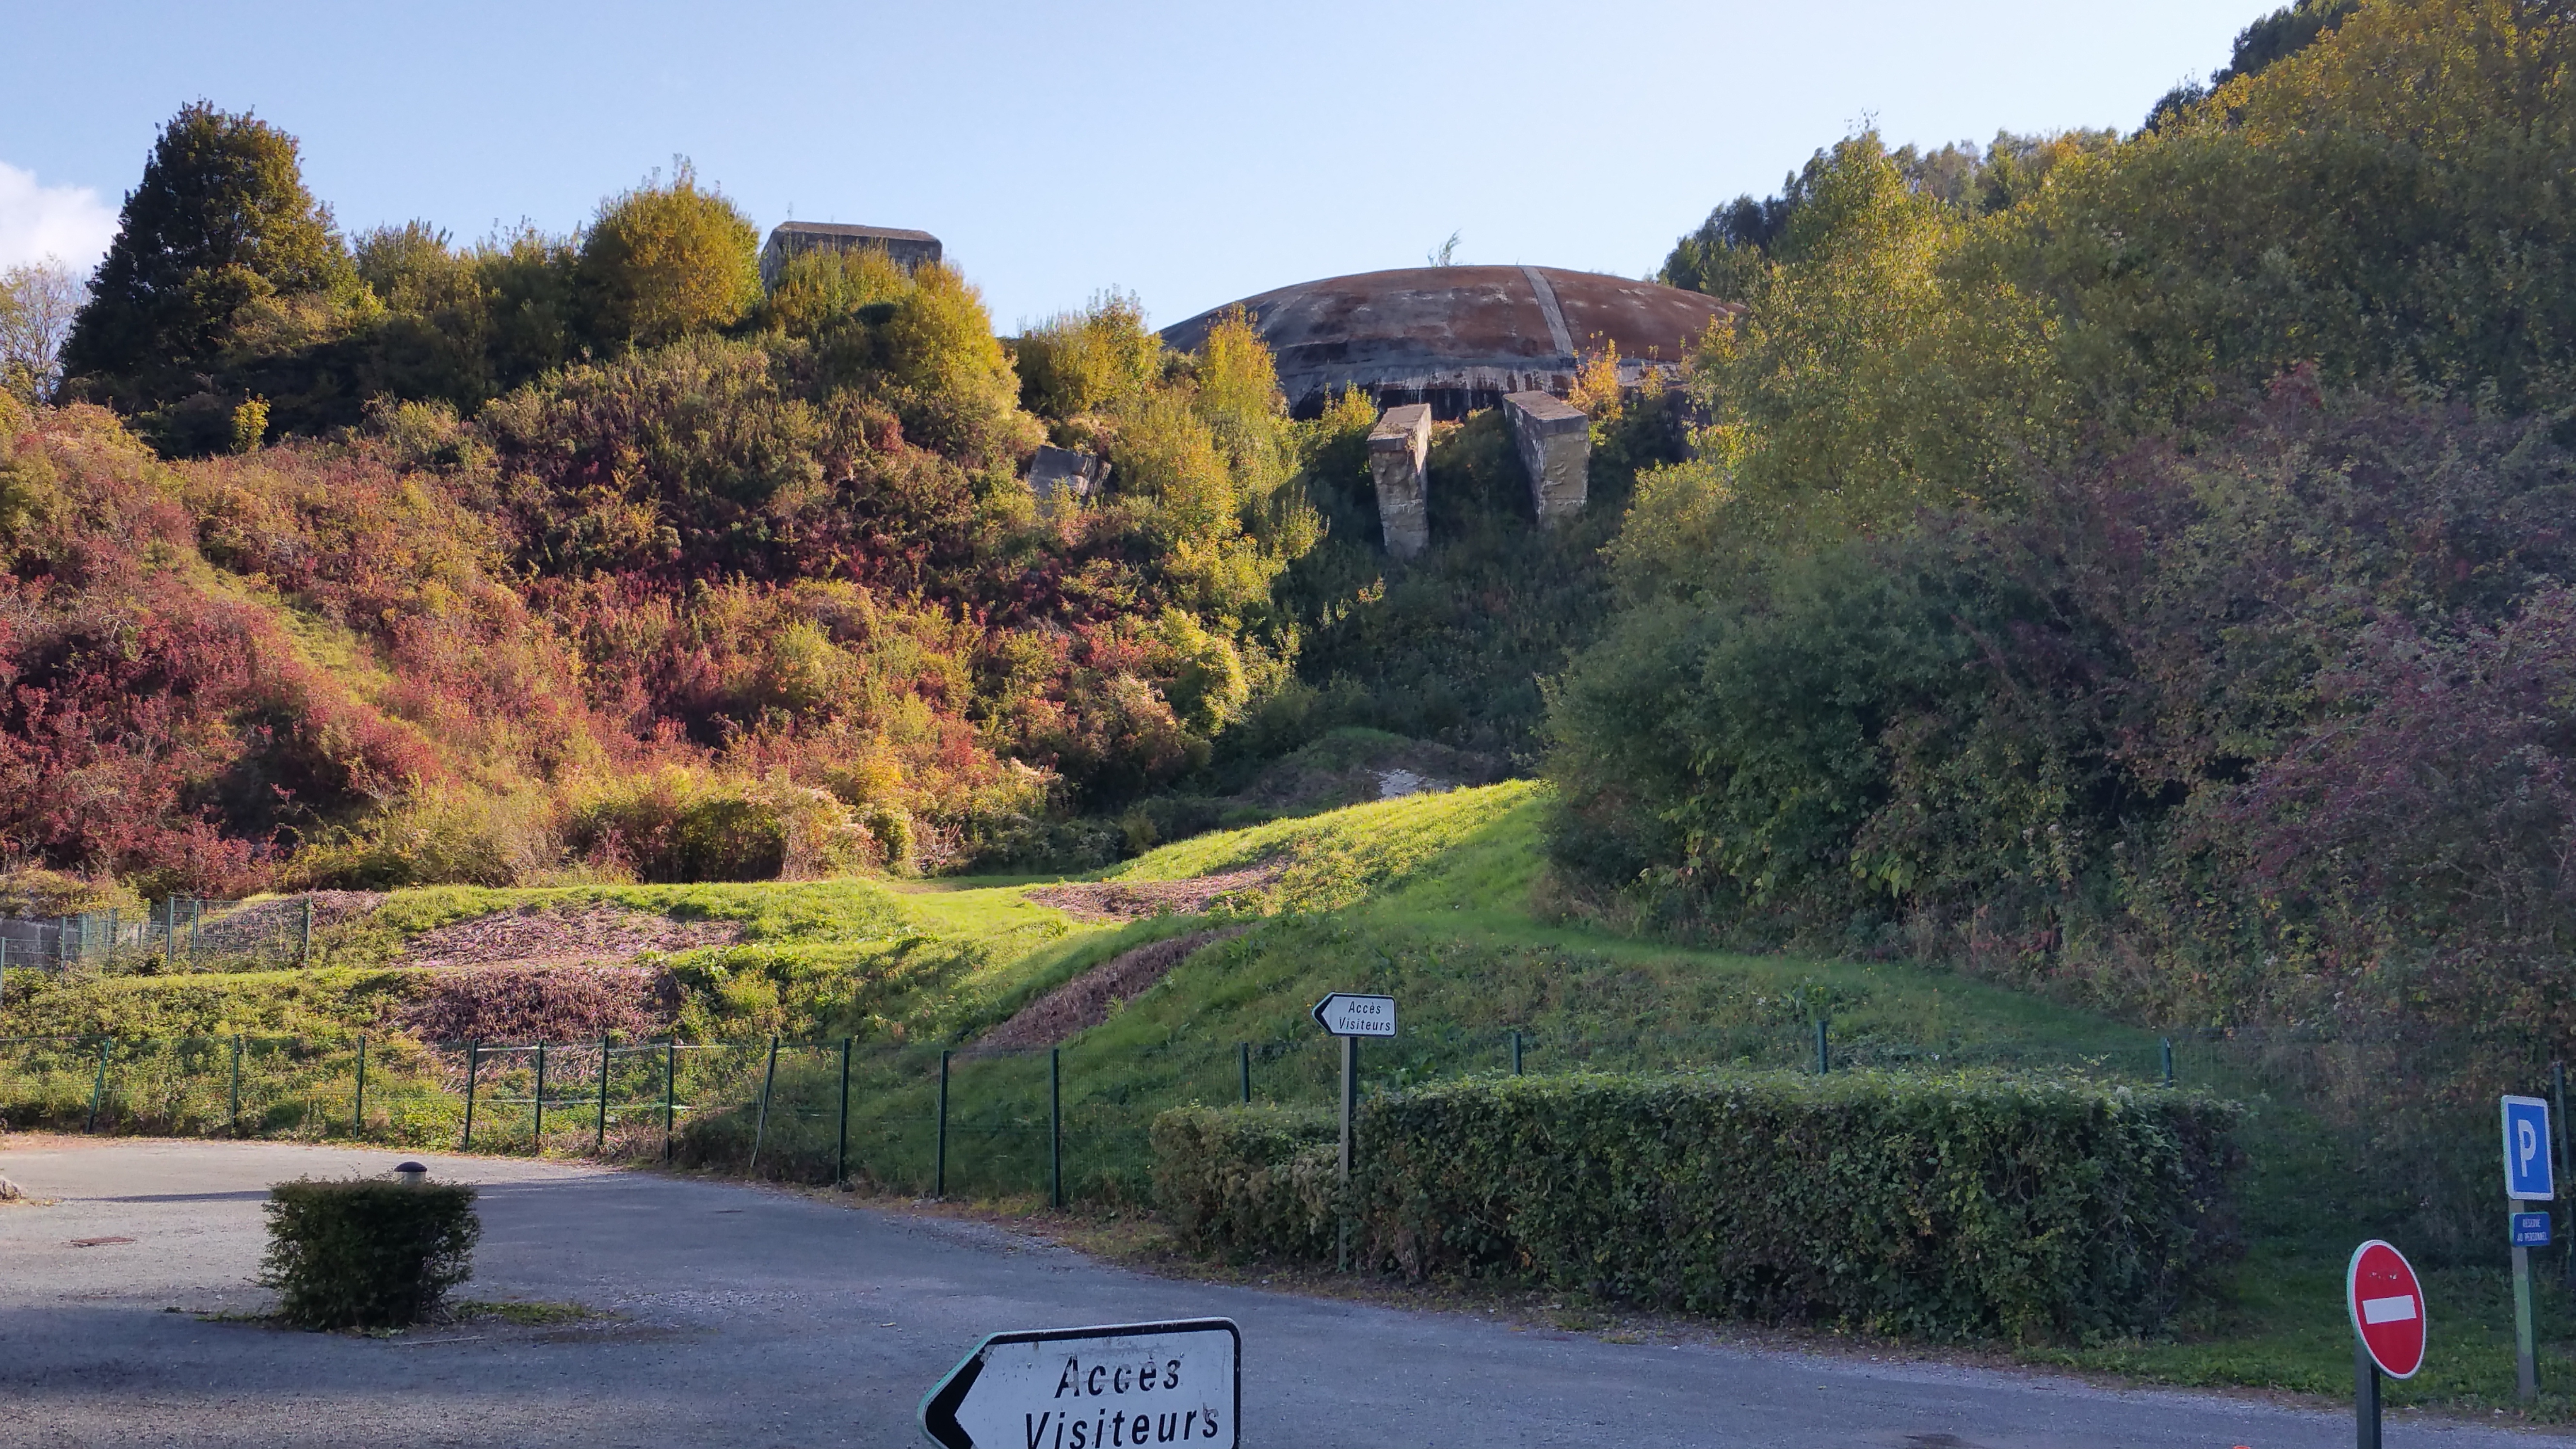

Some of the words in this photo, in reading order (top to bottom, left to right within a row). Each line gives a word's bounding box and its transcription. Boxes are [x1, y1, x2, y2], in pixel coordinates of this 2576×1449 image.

[1348, 1001, 1381, 1014] Accès
[1339, 1016, 1391, 1031] Visiteurs
[2518, 1119, 2536, 1177] P
[2524, 1232, 2547, 1241] PERSONNEL
[1026, 1408, 1219, 1449] Visiteurs
